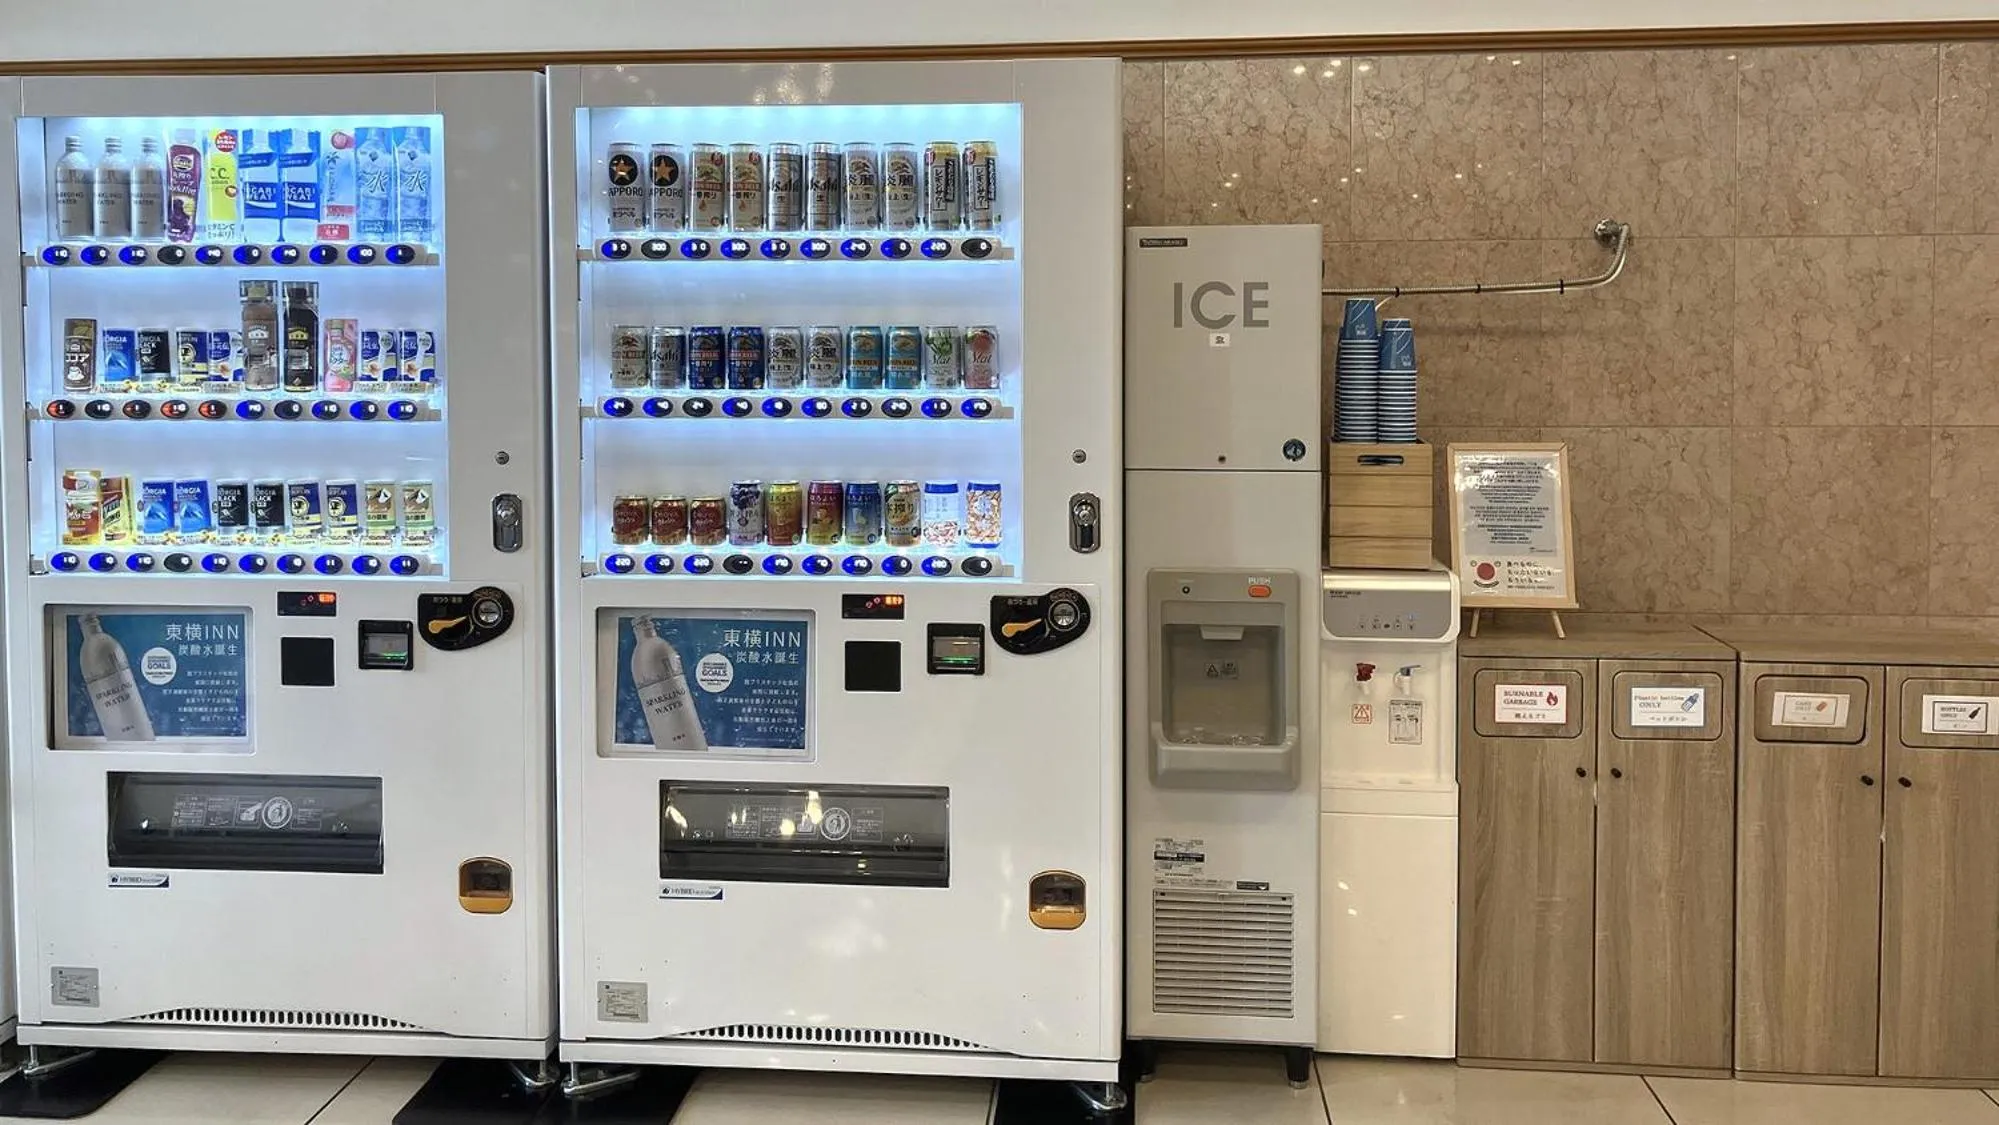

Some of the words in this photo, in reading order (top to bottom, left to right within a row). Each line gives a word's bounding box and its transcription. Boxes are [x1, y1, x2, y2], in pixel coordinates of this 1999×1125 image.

[362, 168, 388, 193] 水
[401, 170, 427, 193] 水
[608, 187, 643, 197] APPORO
[650, 187, 683, 198] APPORO
[1173, 281, 1269, 329] ICE
[166, 623, 239, 641] 東横INN
[723, 629, 801, 648] 東横INN
[178, 643, 238, 656] 炭酸水誕生
[735, 651, 799, 664] 炭酸水誕生
[1503, 690, 1543, 698] BURNABLE
[655, 700, 683, 714] WATER
